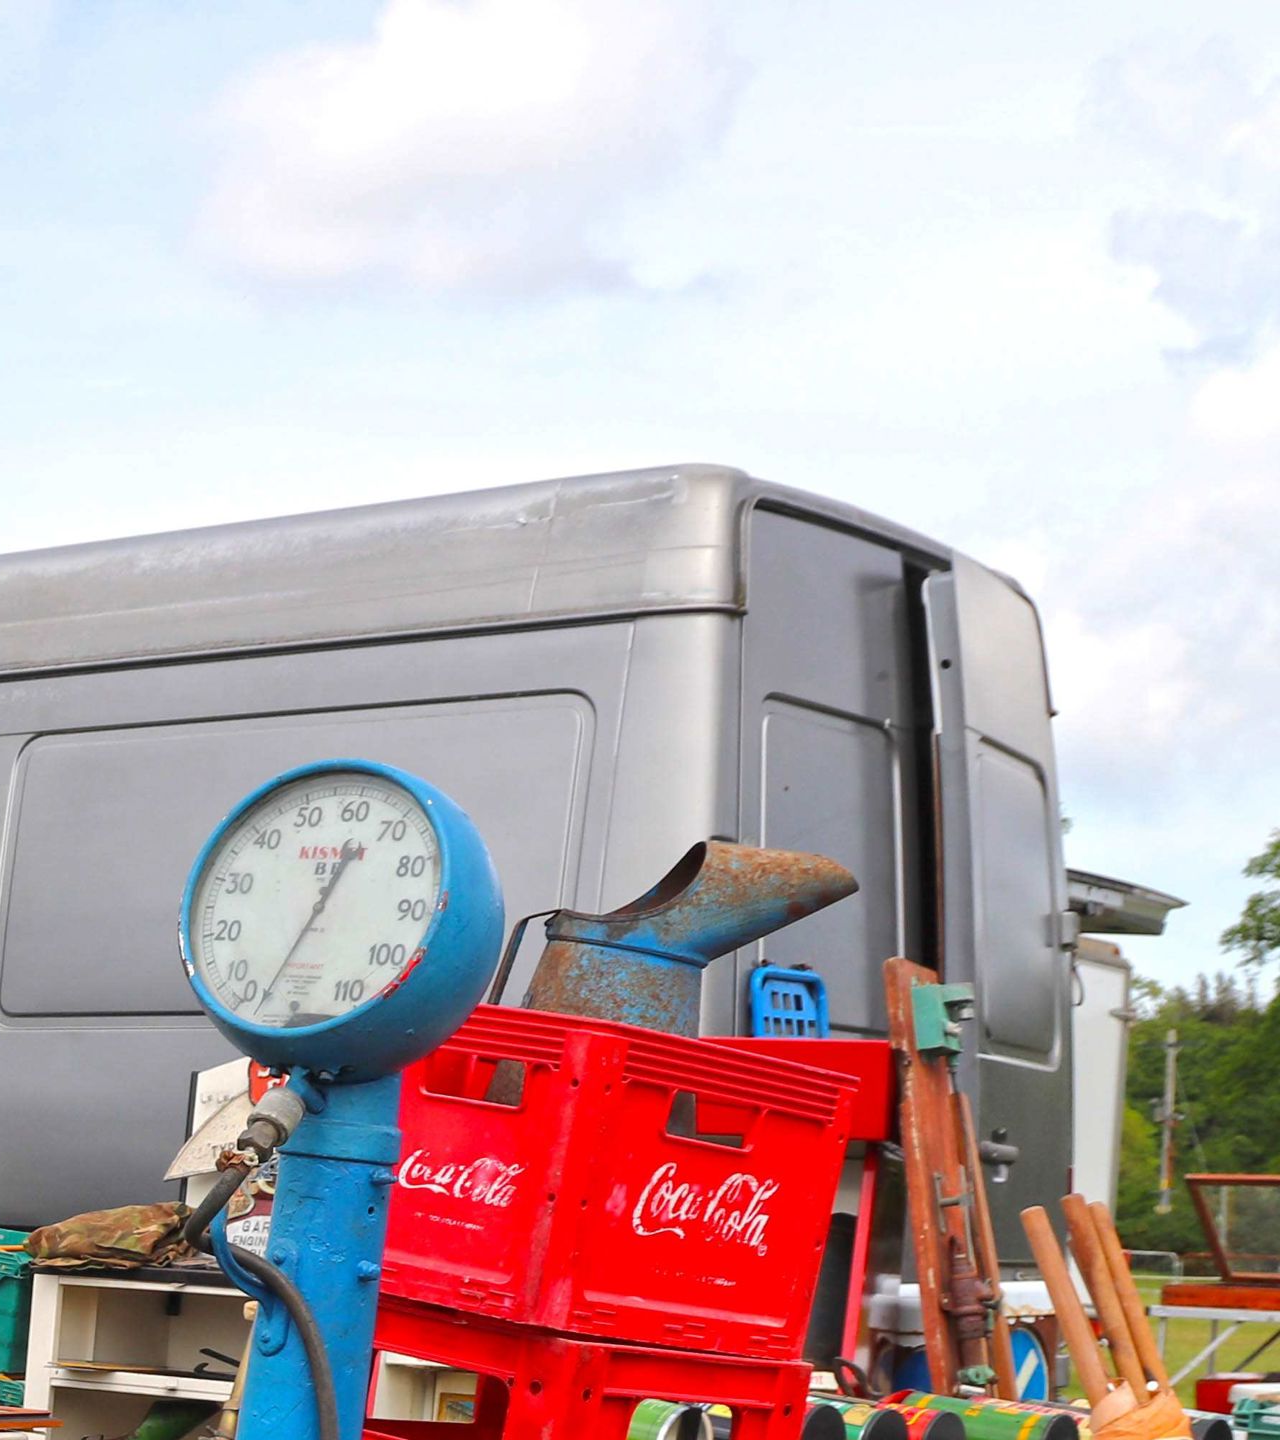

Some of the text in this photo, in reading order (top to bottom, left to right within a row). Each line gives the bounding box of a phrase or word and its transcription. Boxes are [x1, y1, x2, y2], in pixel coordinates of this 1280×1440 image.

[294, 806, 323, 828] 50
[341, 800, 370, 822] 60
[253, 829, 281, 850] 40
[377, 820, 406, 842] 70
[299, 846, 368, 861] KISMT
[396, 855, 424, 878] 80
[225, 872, 253, 895] 30
[397, 899, 426, 921] 90
[215, 920, 241, 942] 20
[369, 943, 406, 966] 100
[228, 959, 248, 981] 10
[244, 980, 257, 1002] 0
[334, 980, 364, 1001] 110
[398, 1149, 525, 1208] Coca-Cola
[632, 1162, 780, 1248] Coca-Cola
